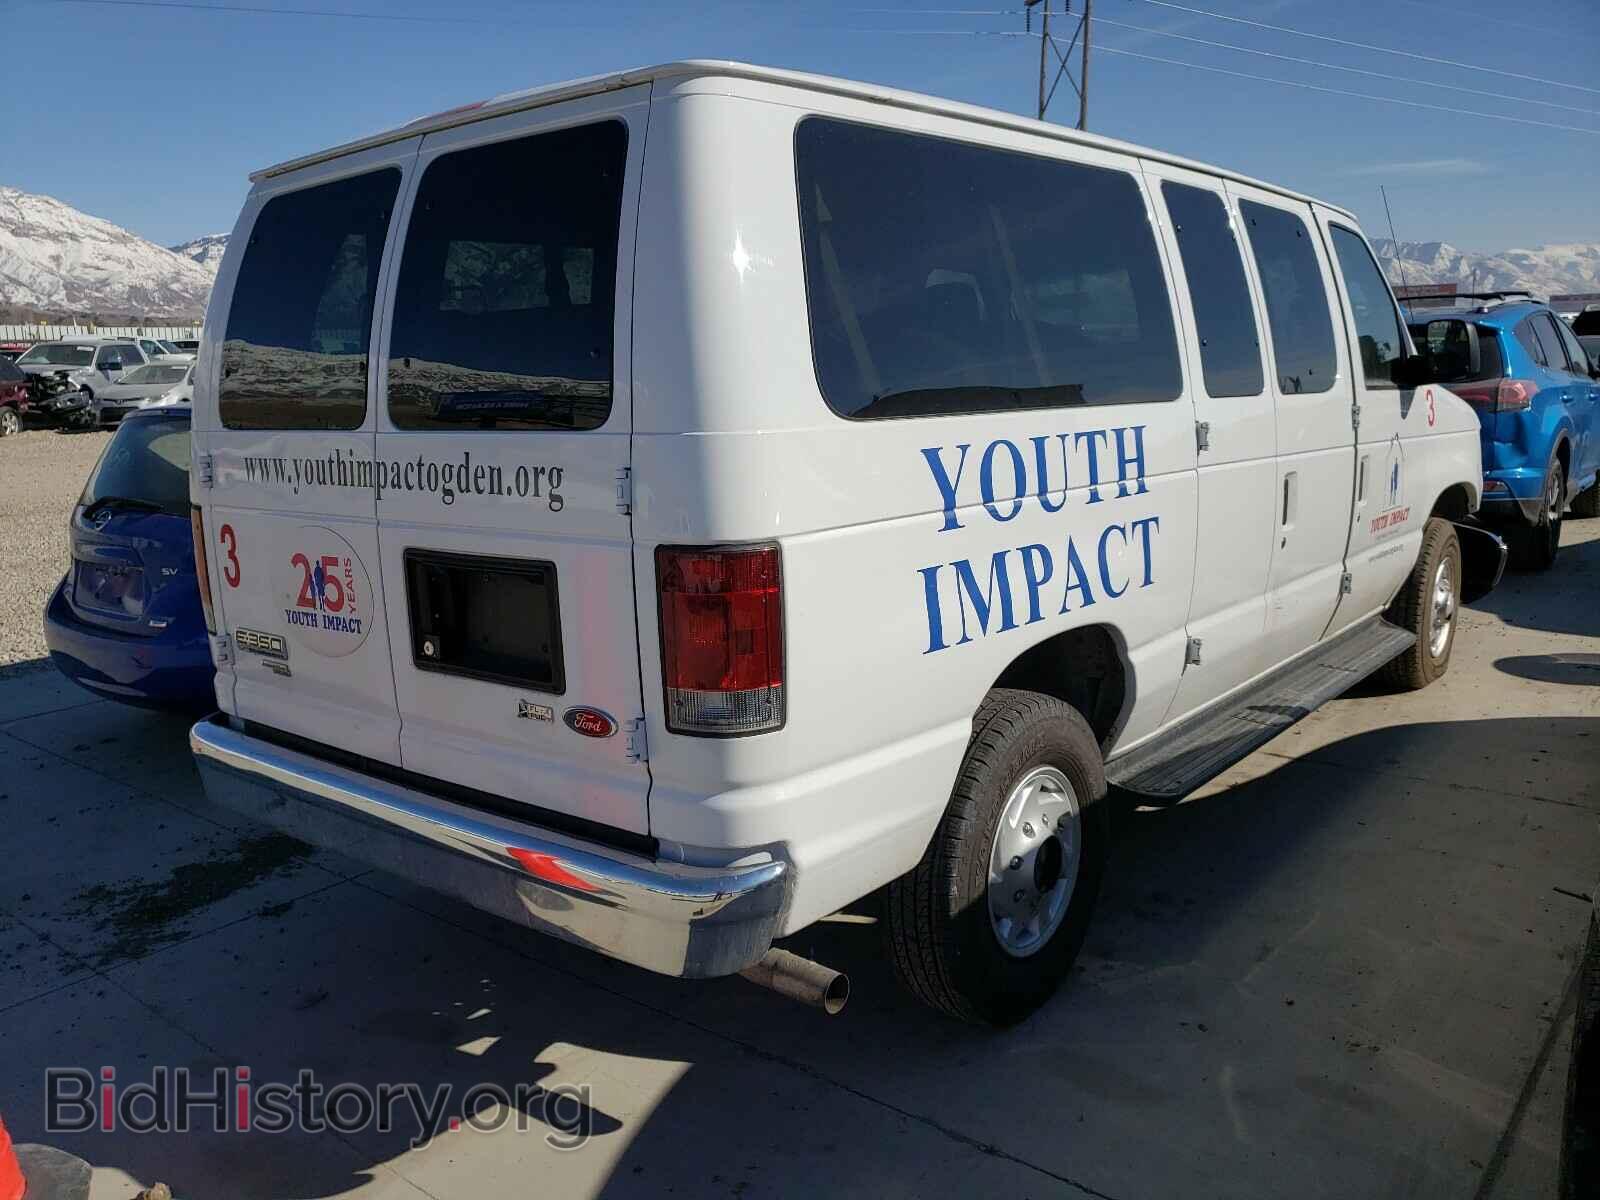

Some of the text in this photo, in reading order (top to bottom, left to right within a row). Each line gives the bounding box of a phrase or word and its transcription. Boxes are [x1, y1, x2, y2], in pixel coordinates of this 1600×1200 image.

[1425, 389, 1436, 427] 3
[243, 449, 564, 512] www.youthimpactogden.org
[920, 425, 1150, 532] YOUTH
[161, 567, 179, 576] SV
[220, 522, 241, 588] 3
[290, 552, 345, 613] 25
[343, 557, 357, 615] YEARS
[917, 516, 1160, 655] IMPACT
[285, 608, 362, 634] YOUTH IMPACT
[574, 712, 602, 732] Ford
